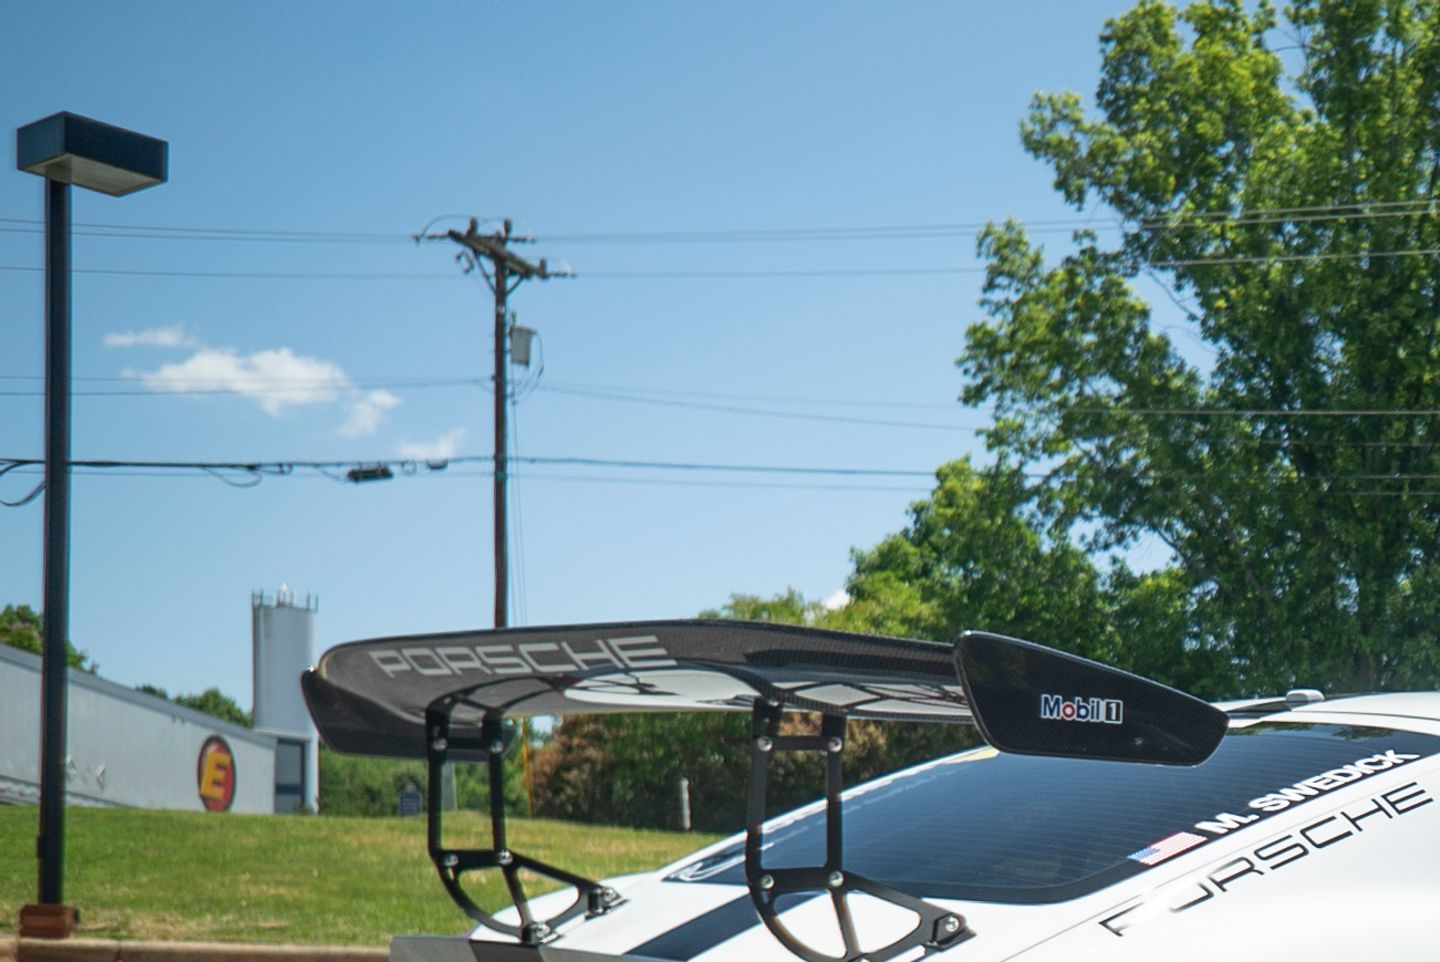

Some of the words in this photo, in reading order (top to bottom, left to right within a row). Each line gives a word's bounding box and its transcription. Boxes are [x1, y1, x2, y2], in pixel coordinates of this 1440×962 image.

[369, 635, 677, 677] PORSCHE
[1041, 694, 1101, 722] Mobil
[1106, 702, 1119, 721] 1
[201, 754, 230, 800] E
[1196, 811, 1258, 836] M.
[1249, 749, 1421, 813] SWEDICK
